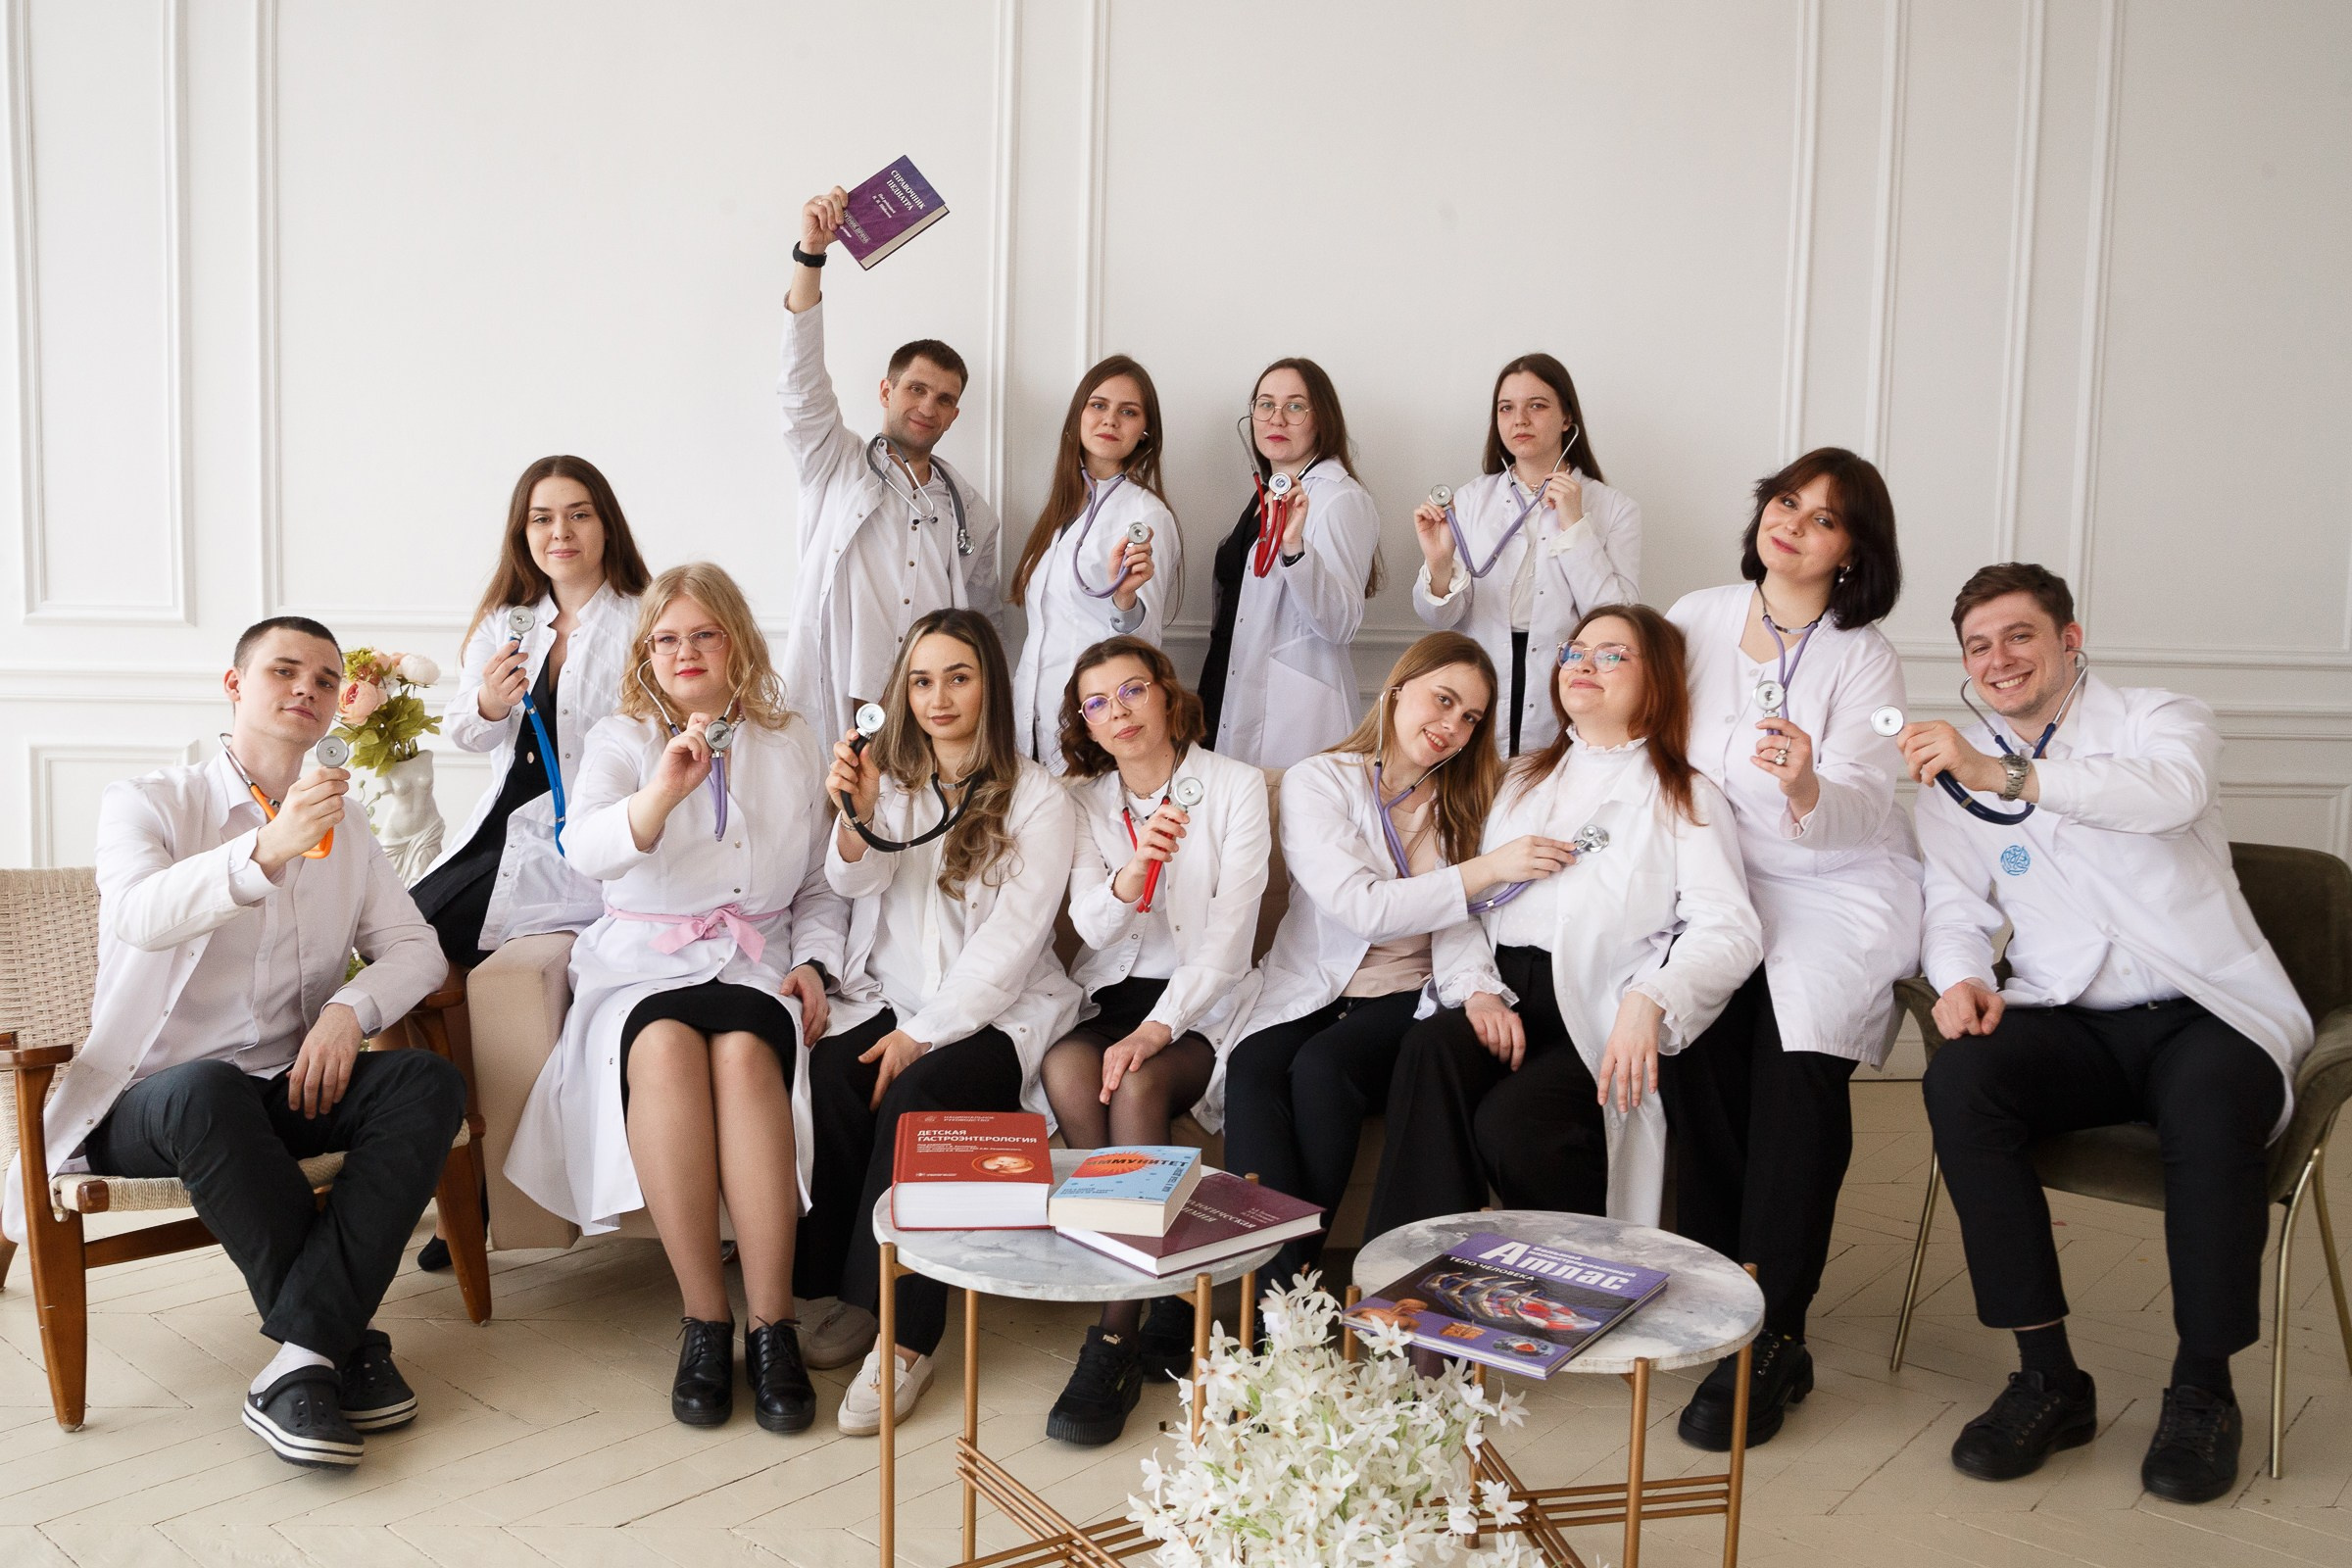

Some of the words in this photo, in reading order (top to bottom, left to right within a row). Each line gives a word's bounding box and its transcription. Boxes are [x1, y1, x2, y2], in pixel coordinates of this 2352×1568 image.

[886, 179, 914, 211] ПЕДИАТРА
[890, 170, 926, 210] СПРАВОЧНИК
[1087, 1158, 1189, 1167] ИММУНИТЕТ
[1449, 1256, 1478, 1268] ТЕЛО
[1479, 1263, 1536, 1282] ЧЕЛОВЕКА
[1478, 1241, 1630, 1291] Атлас
